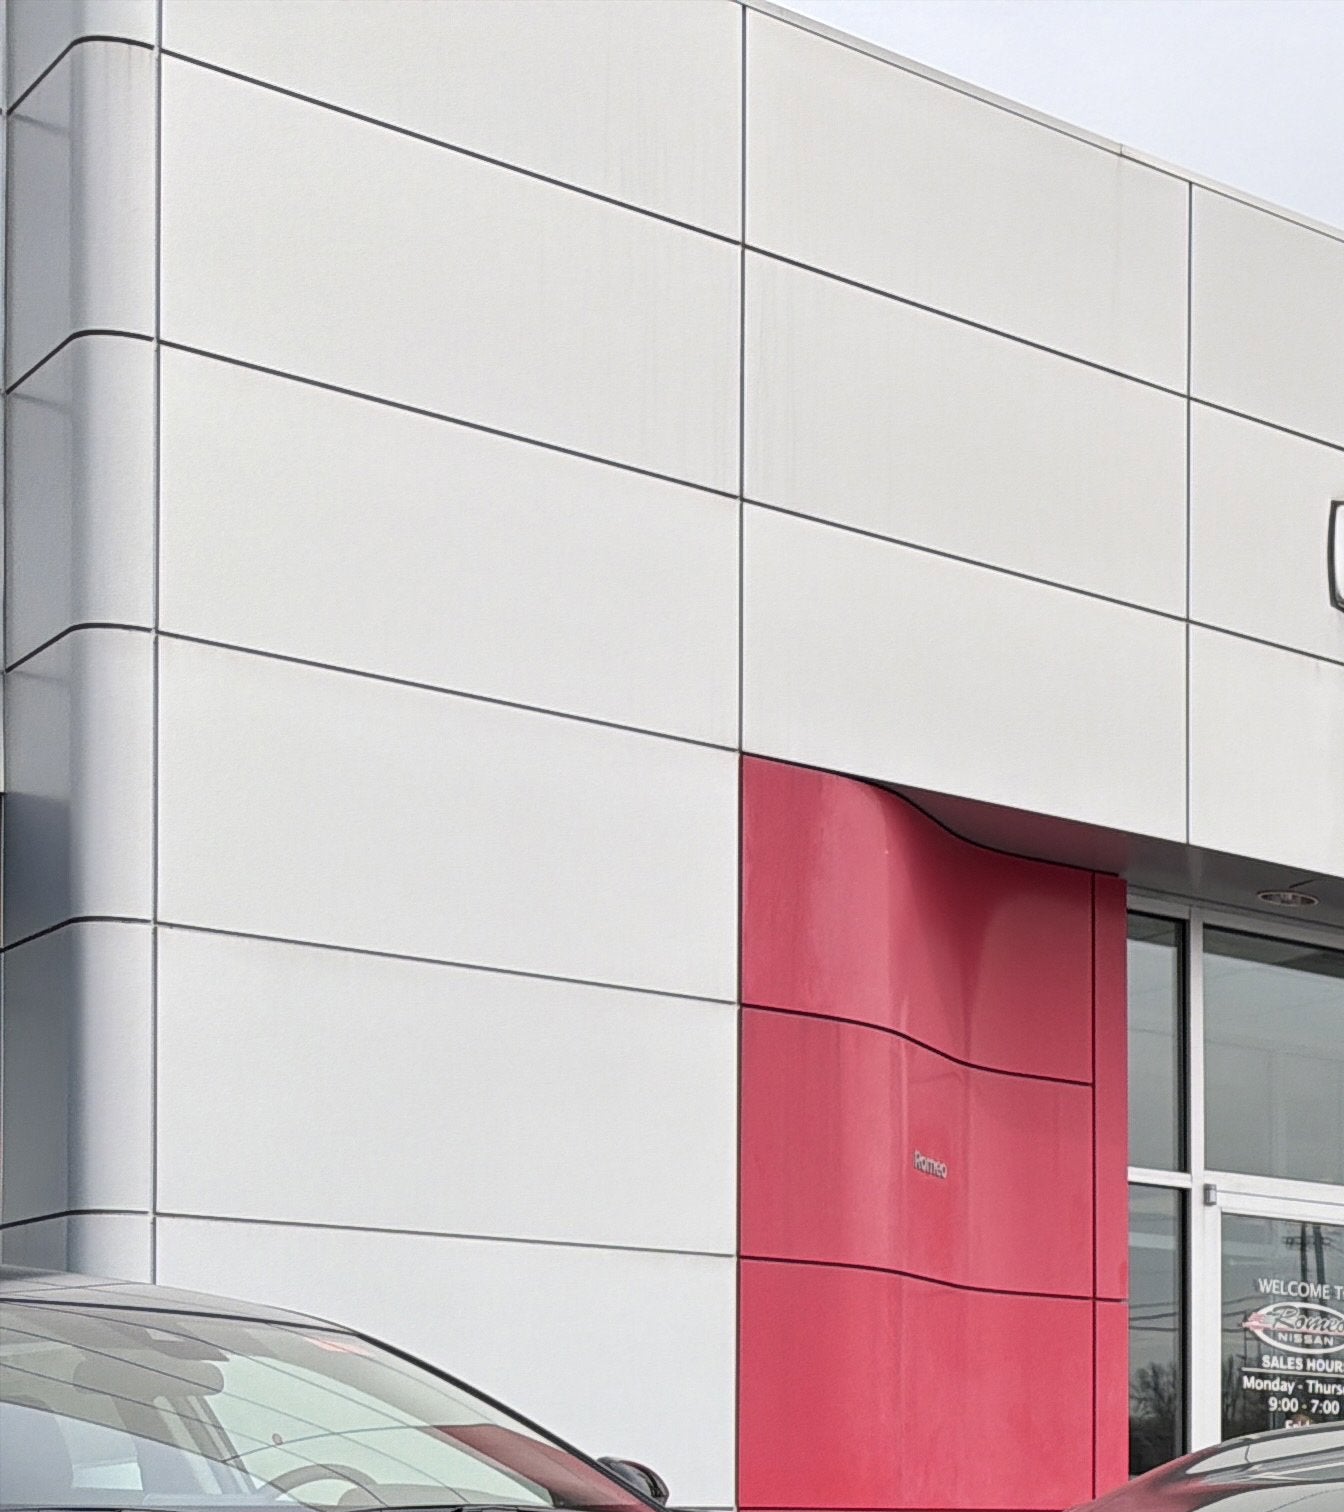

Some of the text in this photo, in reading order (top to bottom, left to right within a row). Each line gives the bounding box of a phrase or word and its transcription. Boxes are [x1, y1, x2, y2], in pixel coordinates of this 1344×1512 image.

[1258, 1278, 1330, 1299] WELCOME
[1277, 1333, 1334, 1346] NISSAN
[1262, 1355, 1303, 1371] SALES
[1242, 1375, 1296, 1394] Monday
[1268, 1397, 1299, 1412] 9:00
[1311, 1399, 1340, 1414] 7:00
